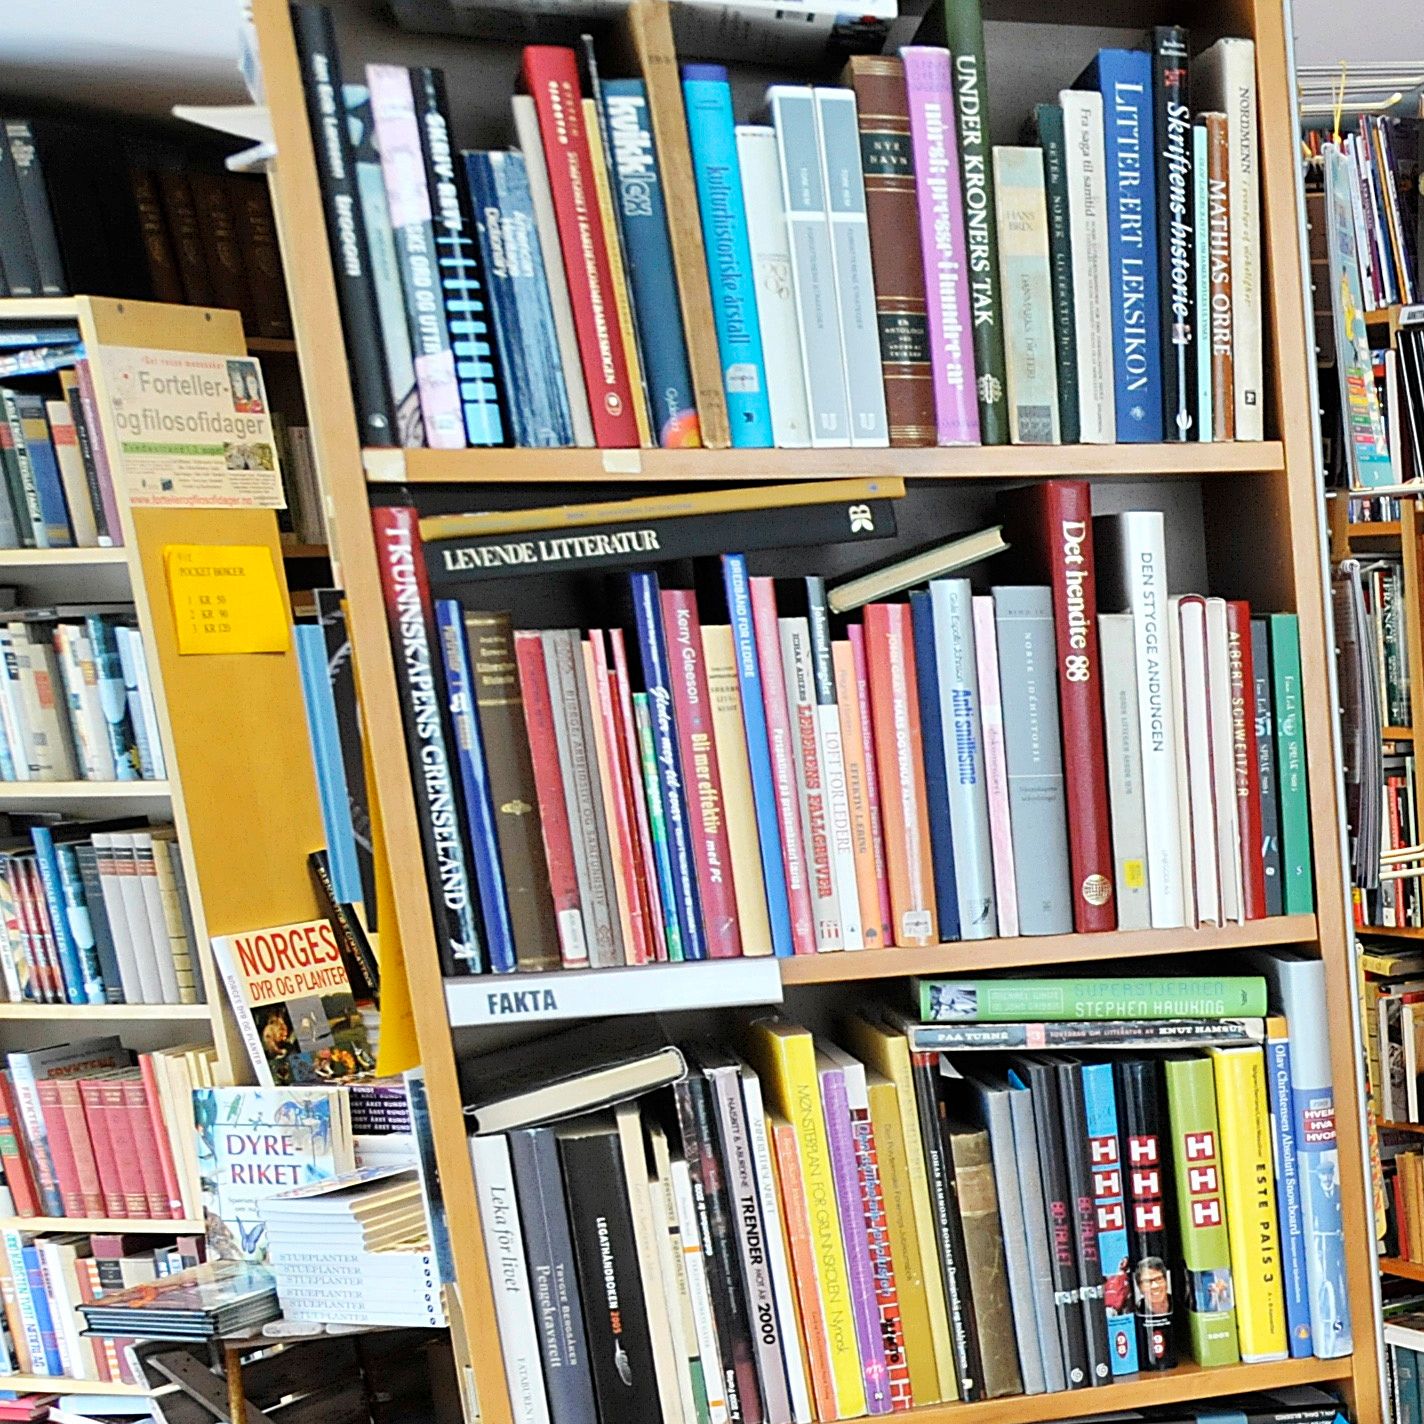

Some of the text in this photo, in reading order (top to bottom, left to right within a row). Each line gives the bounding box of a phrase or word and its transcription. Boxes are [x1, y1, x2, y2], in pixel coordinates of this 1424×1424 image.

[957, 54, 993, 326] UNDER KRONERS TAK
[1160, 101, 1193, 316] Skriftens historie
[703, 163, 745, 291] kulturhistoriske
[1115, 81, 1147, 392] LITTERÆRT LEKSIKON
[1208, 179, 1230, 356] MATHIAS ORRE
[138, 371, 230, 397] Forteller-
[117, 408, 266, 439] og filosofidager
[441, 528, 660, 571] LEVENDE LITTERATUR
[1061, 520, 1090, 681] Det hendte 88
[1141, 552, 1163, 752] DEN STYGGE ANDUNGEN
[386, 541, 441, 738] KUNNSKAPENS
[420, 743, 468, 909] GRENSELAND
[674, 608, 722, 883] Kerry Gleeson Bli mer effektiv med PC
[236, 924, 339, 976] NORGES
[249, 967, 348, 1002] DYR OG PLANTER
[486, 987, 558, 1016] FAKTA
[1074, 981, 1225, 997] SUPERSTJERNEN
[1075, 999, 1225, 1018] STEPHEN HAWKING
[226, 1133, 303, 1156] DYRE-
[1092, 1138, 1116, 1162] H
[1131, 1139, 1157, 1164] H
[1187, 1134, 1213, 1158] H
[1274, 1044, 1300, 1235] Olav Christensen Absolutt Snowboard
[230, 1164, 302, 1185] RIKET
[1095, 1172, 1120, 1197] H
[1132, 1172, 1159, 1197] H
[1191, 1167, 1217, 1192] H
[795, 1083, 850, 1354] MØNSTERPLAN FOR GRUNNSKOLEN Nynorsk
[1098, 1205, 1124, 1229] H
[1136, 1206, 1162, 1231] H
[1194, 1202, 1220, 1226] H
[1256, 1164, 1274, 1282] ESTE PAÍS 3
[489, 1184, 523, 1293] Leka för livet
[740, 1195, 776, 1344] TRENDER 2000
[534, 1264, 565, 1367] Pengekravsrett
[555, 1263, 577, 1365] TRYGVE BERGSÅKER
